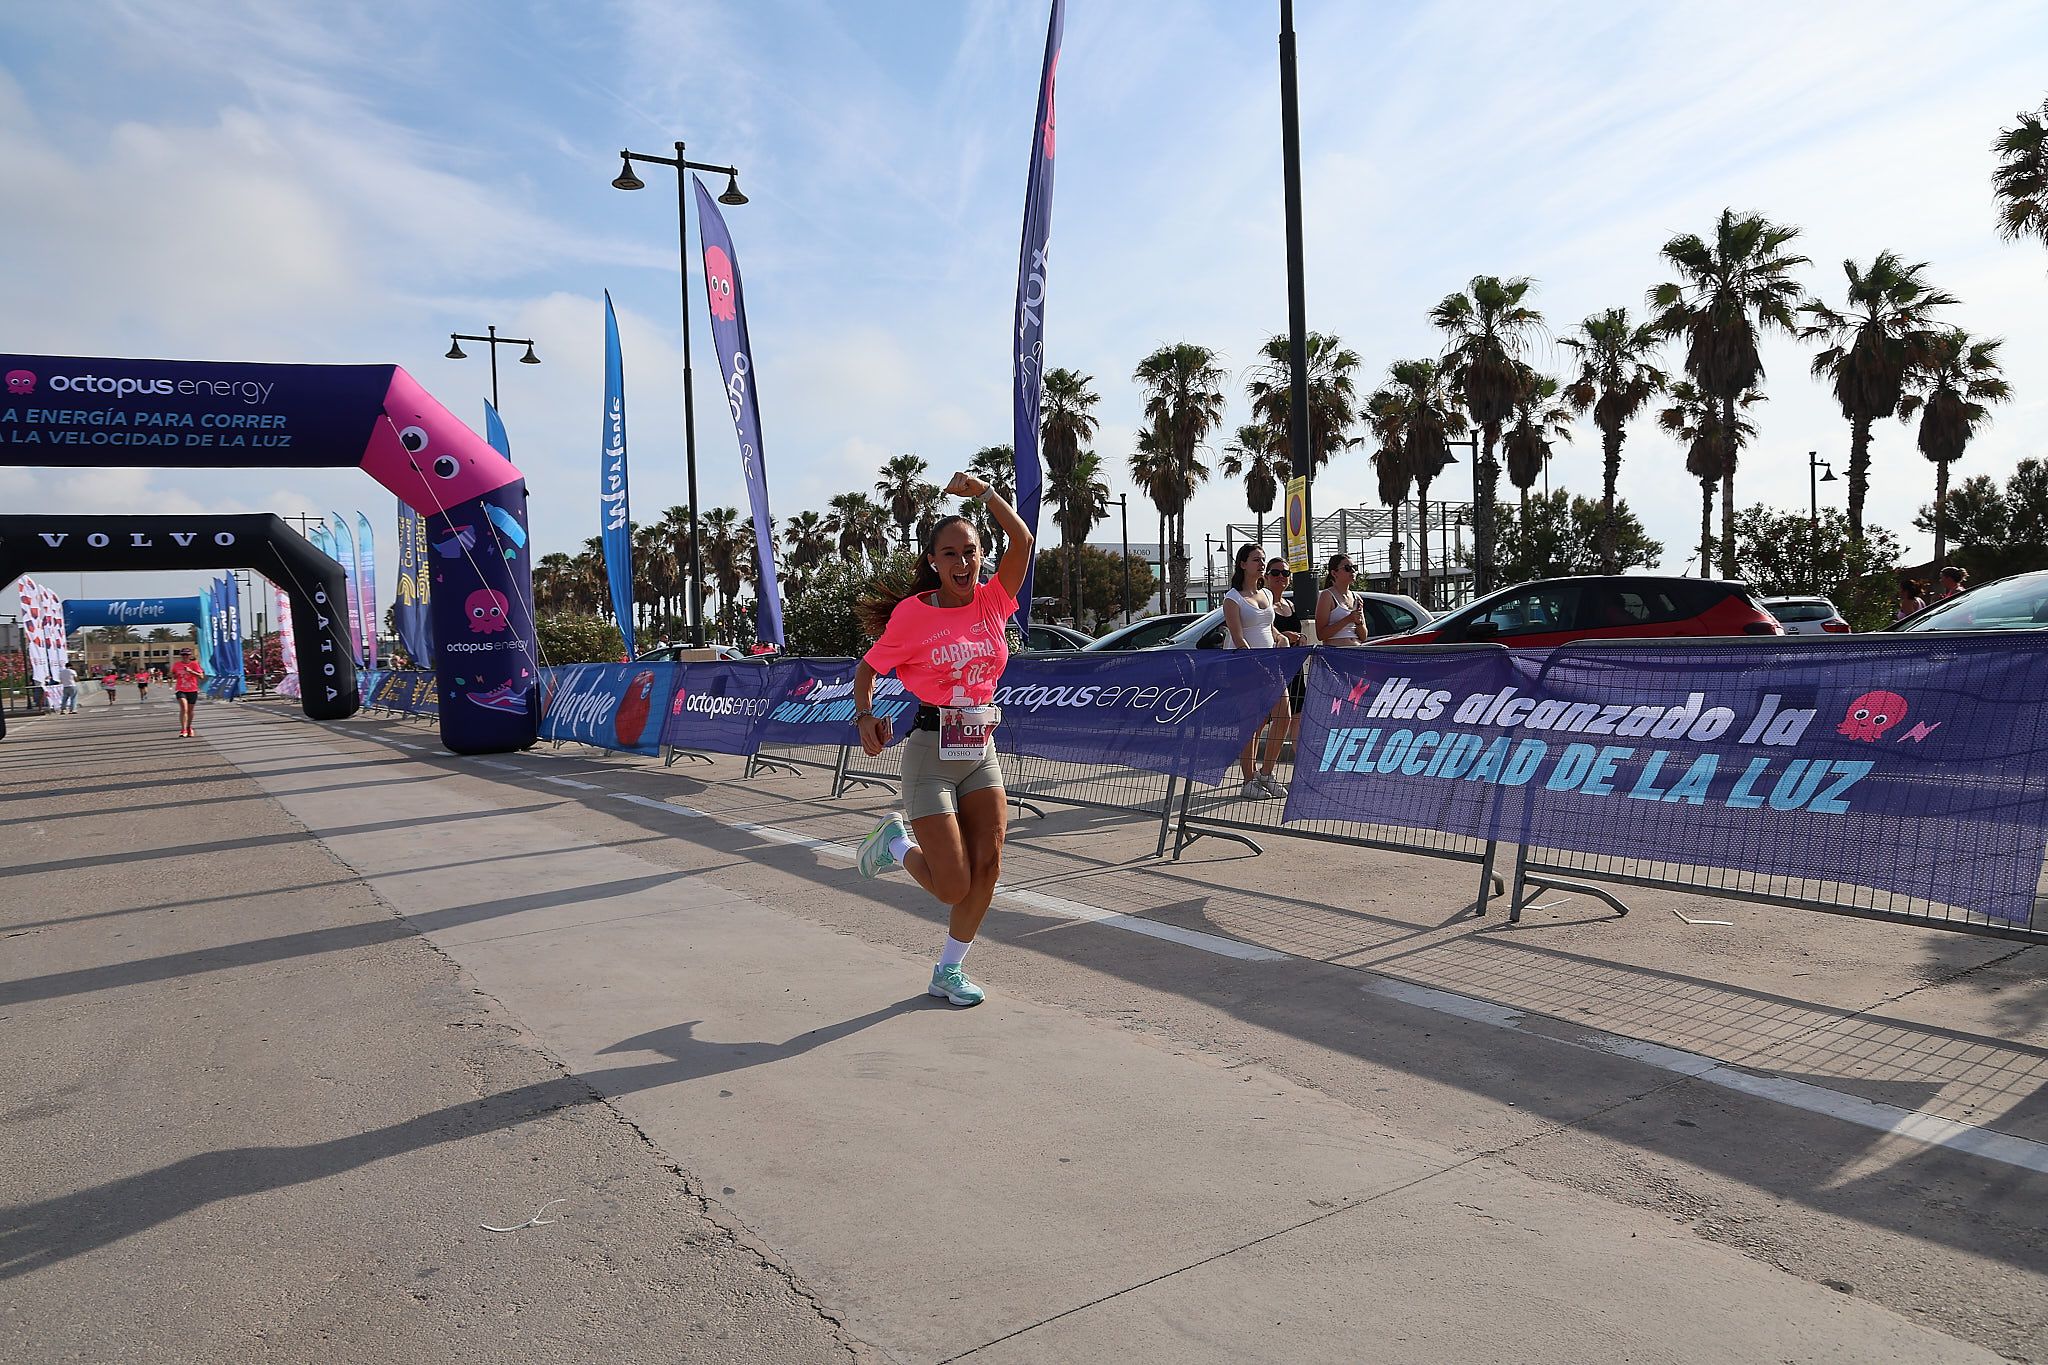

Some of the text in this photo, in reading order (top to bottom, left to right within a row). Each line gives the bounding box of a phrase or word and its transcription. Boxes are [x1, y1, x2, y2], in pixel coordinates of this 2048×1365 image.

[50, 374, 274, 405] octopus energy
[25, 407, 128, 426] ENERGÍA
[134, 412, 194, 428] PARA
[200, 413, 287, 429] CORRER
[11, 430, 41, 444] LA
[48, 431, 179, 447] VELOCIDAD
[185, 434, 214, 447] DE
[219, 435, 245, 447] LA
[252, 435, 292, 447] LUZ
[38, 532, 237, 549] VOLVO
[107, 600, 166, 623] Marlene
[446, 639, 529, 654] octopus energy
[546, 666, 616, 740] Marlene
[686, 692, 734, 720] octopus
[992, 684, 1218, 725] octopus energy
[1366, 677, 1818, 747] Has alcanzado la
[1319, 728, 1876, 815] VELOCIDAD DE LA LUZ
